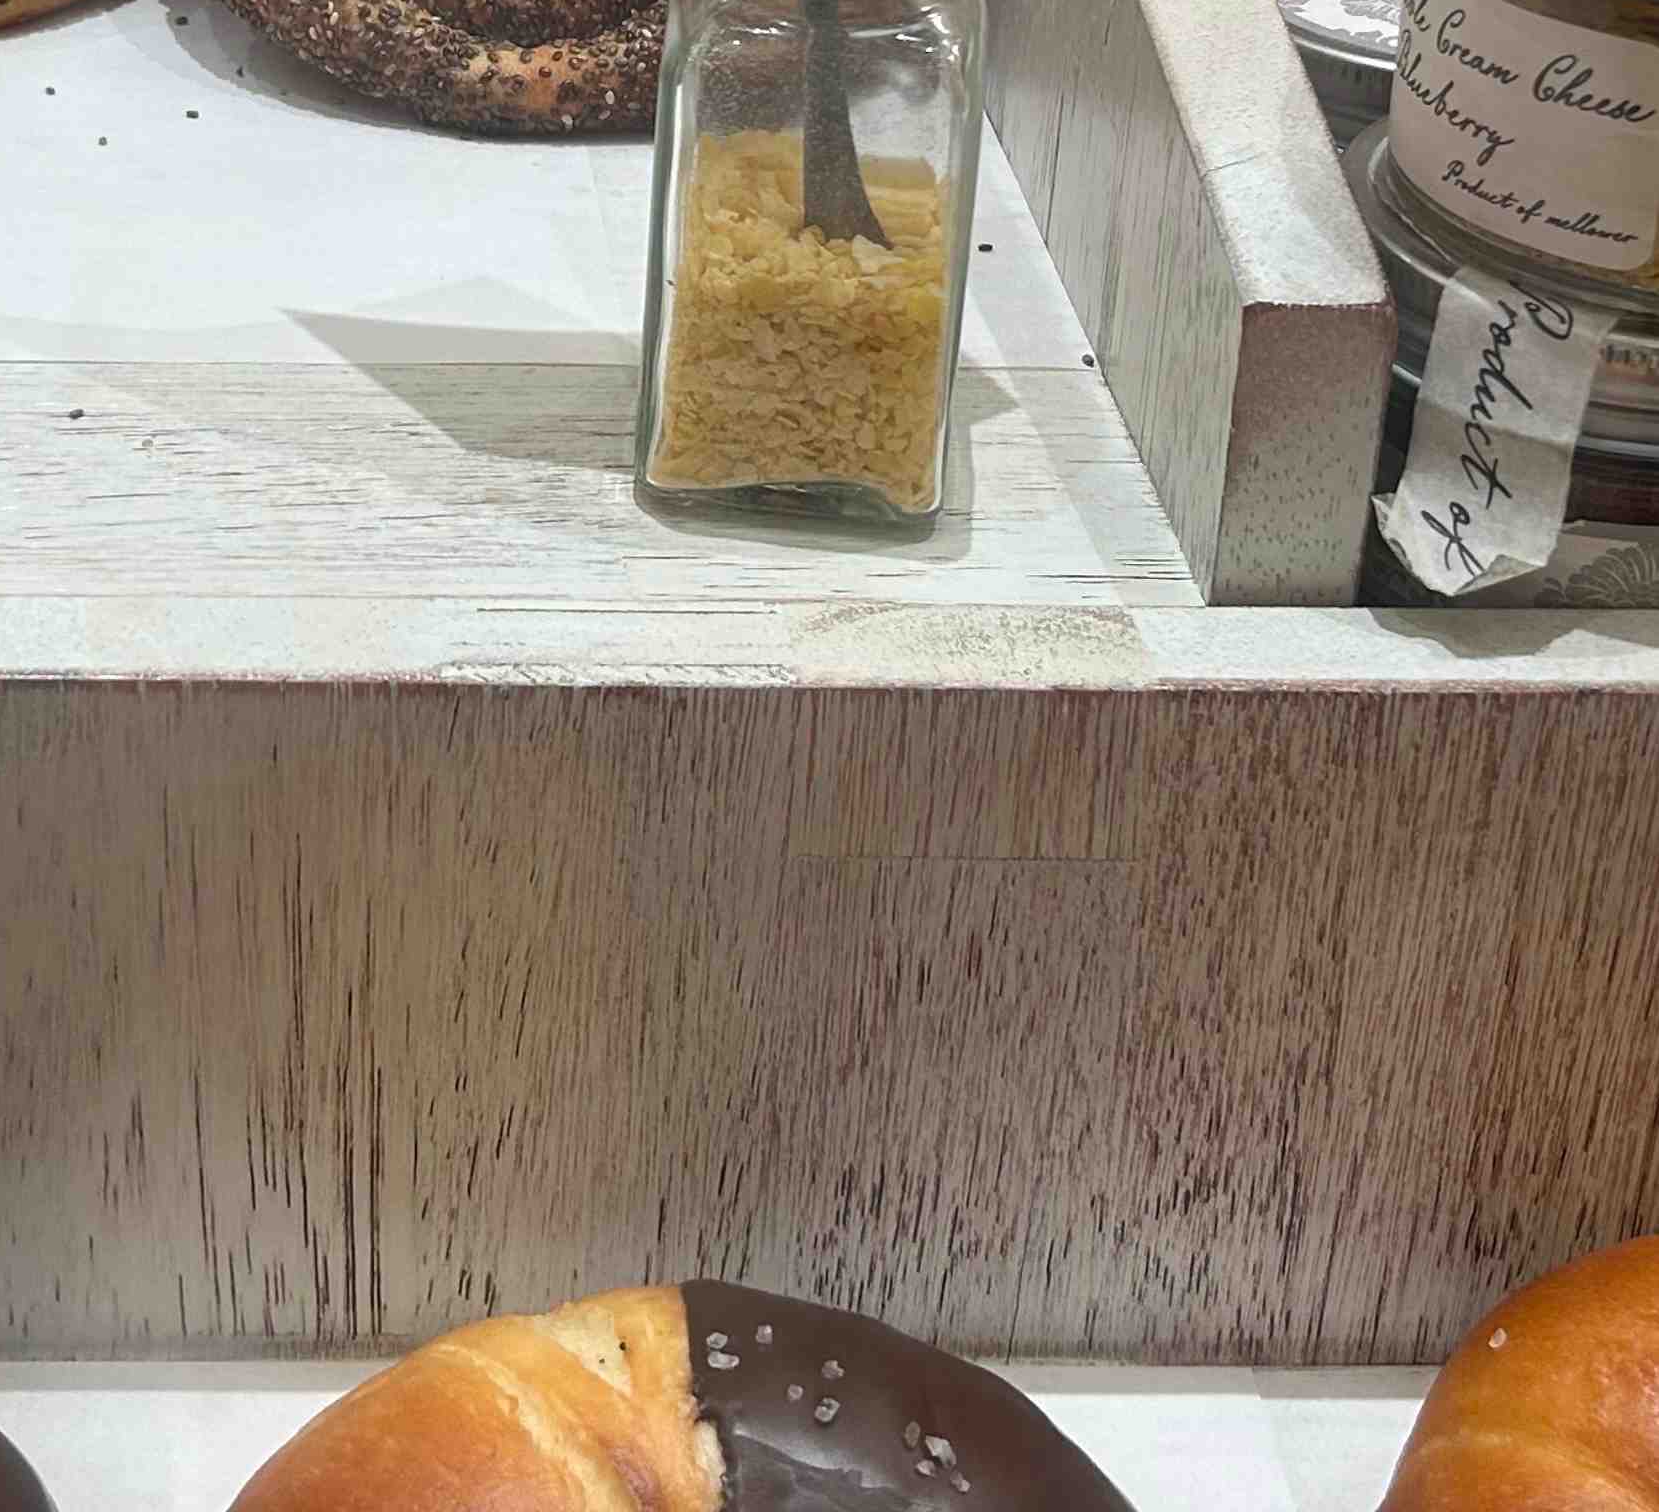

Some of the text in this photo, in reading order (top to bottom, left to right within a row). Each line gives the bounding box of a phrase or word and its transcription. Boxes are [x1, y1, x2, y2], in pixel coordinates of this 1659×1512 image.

[1397, 28, 1516, 167] Blueberry
[1436, 8, 1520, 85] Cream
[1532, 53, 1658, 123] Cheese
[1441, 160, 1520, 209] Product
[1516, 199, 1546, 225] of
